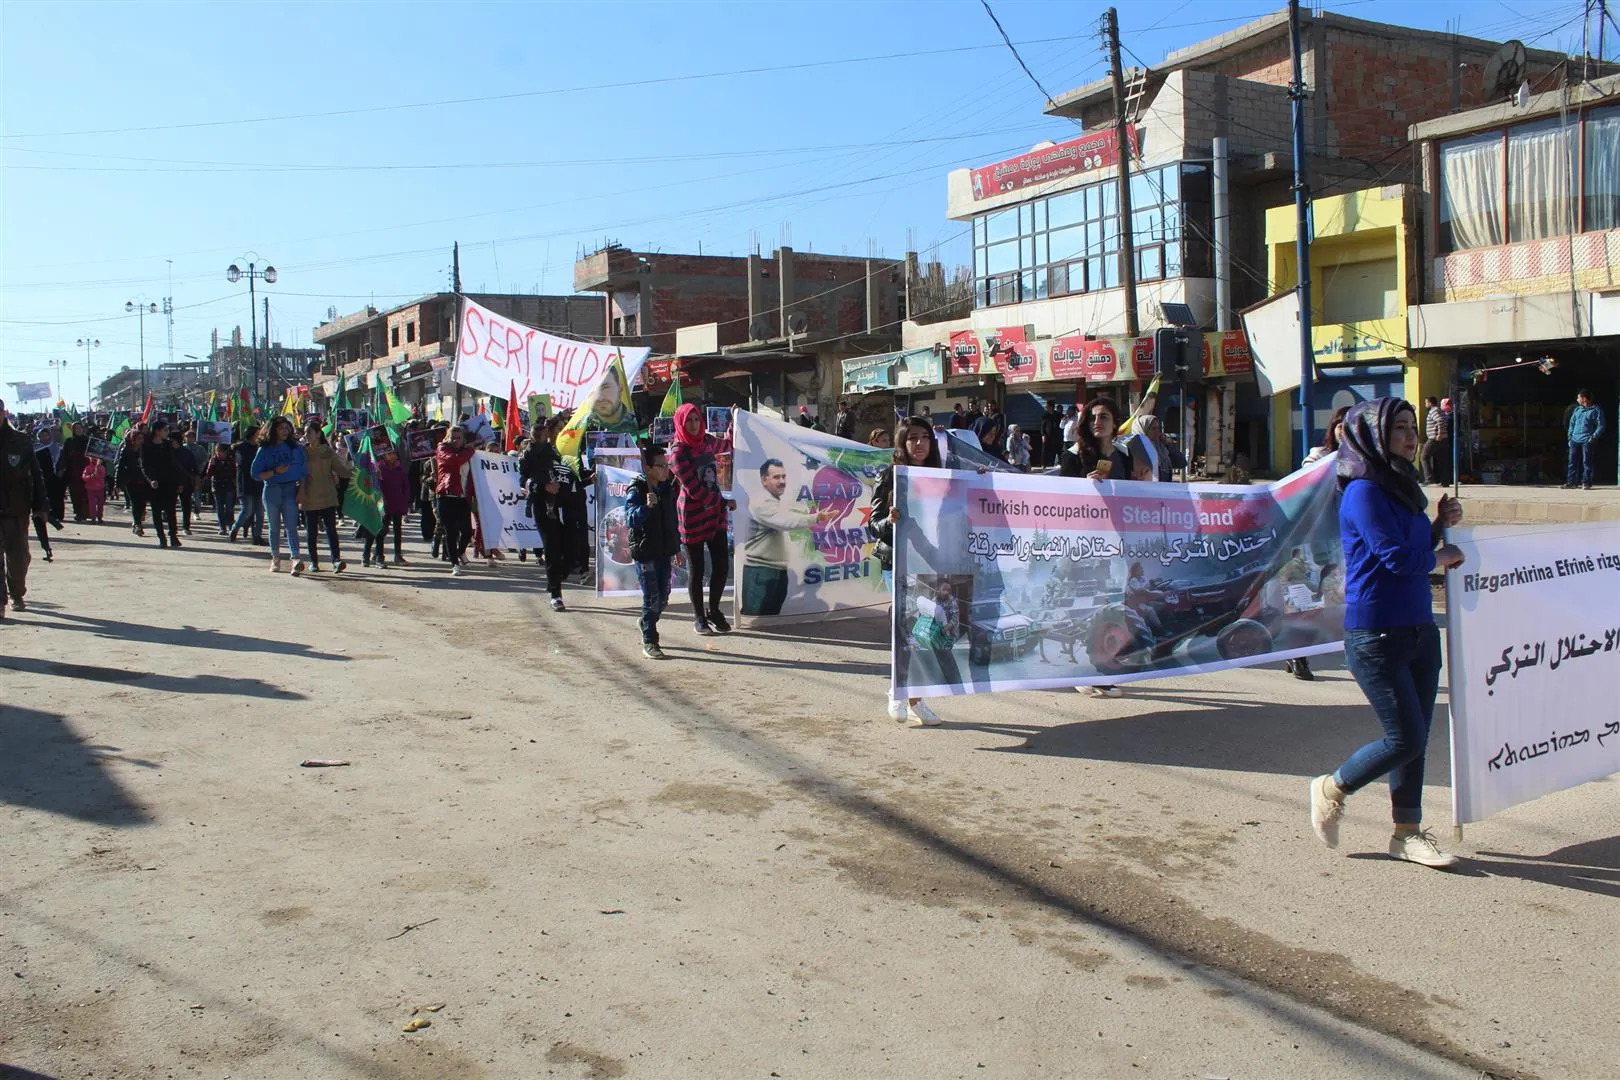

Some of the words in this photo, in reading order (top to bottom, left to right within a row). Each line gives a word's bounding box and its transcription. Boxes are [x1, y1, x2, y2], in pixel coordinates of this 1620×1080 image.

[993, 163, 1019, 181] دمشق
[1019, 157, 1042, 173] بوابة
[954, 338, 977, 360] دمشق
[1053, 347, 1083, 364] بوابة
[1337, 335, 1384, 352] مكتبة
[1086, 349, 1112, 368] دمشق
[480, 459, 499, 470] Na
[978, 498, 1029, 516] Turkish
[1033, 503, 1110, 521] occupation
[1121, 505, 1195, 529] Stealing
[1199, 508, 1234, 526] and
[967, 532, 1031, 562] والسرقة
[1029, 534, 1071, 561] النهب
[1071, 535, 1124, 562] احتلال
[1217, 527, 1277, 562] احتلال
[1463, 565, 1554, 593] Rizgarkirina
[1555, 556, 1595, 577] Efrînê
[1485, 639, 1546, 696] التركي
